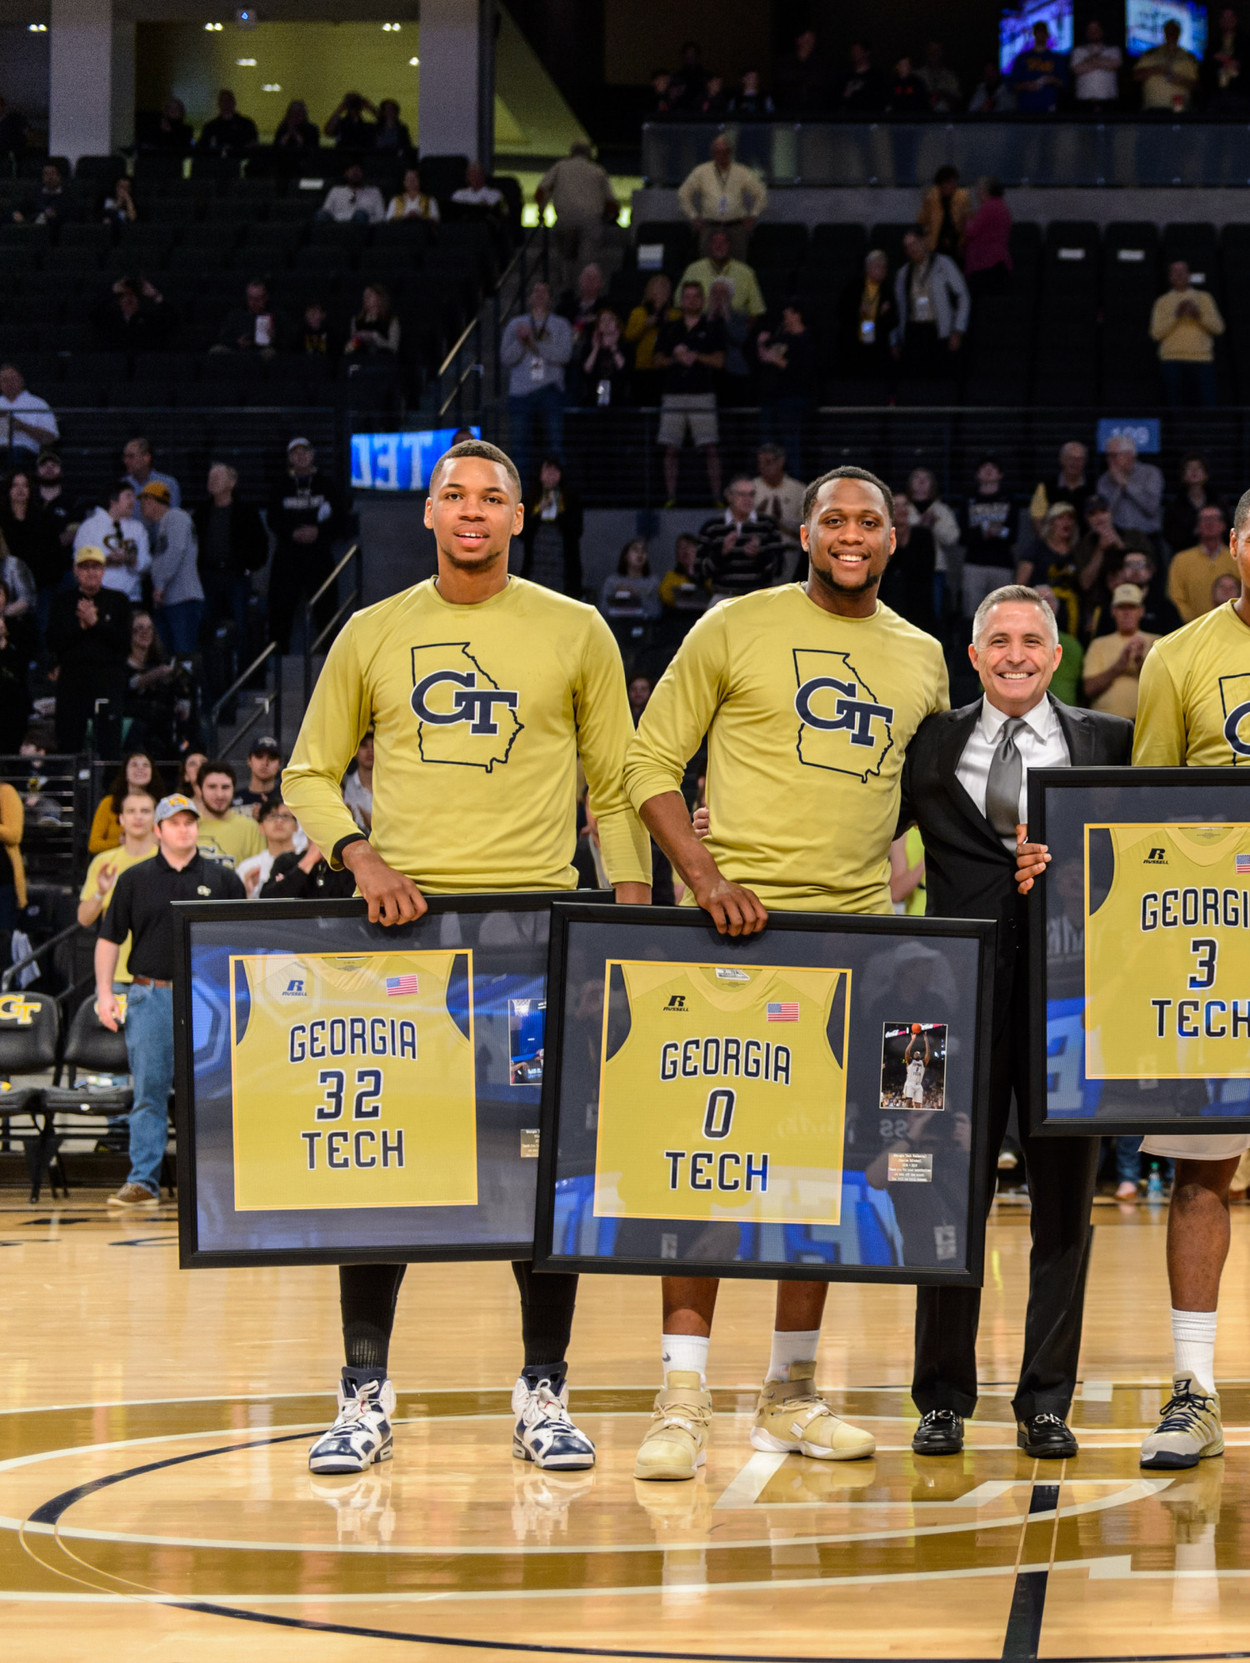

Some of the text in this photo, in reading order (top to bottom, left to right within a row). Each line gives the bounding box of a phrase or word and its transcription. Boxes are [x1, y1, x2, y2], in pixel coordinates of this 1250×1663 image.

[410, 669, 519, 736] GT
[794, 676, 895, 749] GT
[1187, 937, 1218, 991] 3
[0, 994, 42, 1025] GT
[289, 1016, 418, 1064] GEORGIA
[660, 1037, 791, 1085] GEORGIA
[315, 1067, 384, 1122] 32
[702, 1087, 737, 1140] 0
[301, 1130, 405, 1170] TECH
[664, 1150, 770, 1193] TECH
